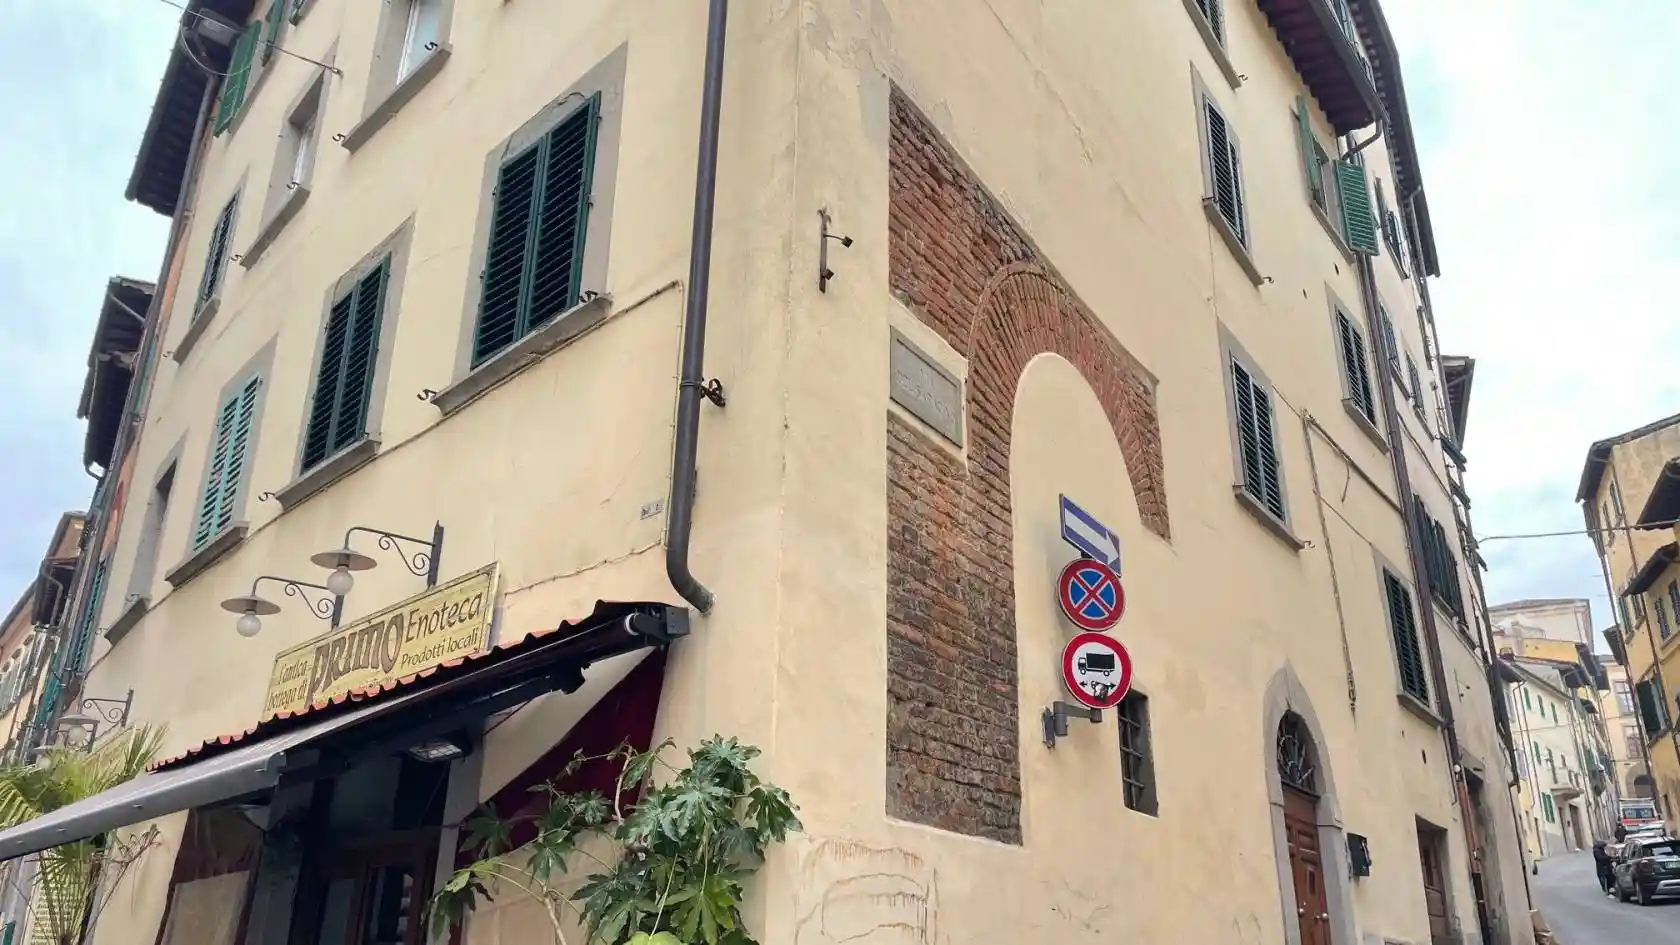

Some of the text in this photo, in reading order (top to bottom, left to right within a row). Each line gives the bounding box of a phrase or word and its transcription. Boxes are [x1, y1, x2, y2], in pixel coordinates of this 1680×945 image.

[404, 592, 483, 644] Enoteca
[304, 613, 404, 709] PRIMO
[401, 627, 479, 670] Prodotti locali
